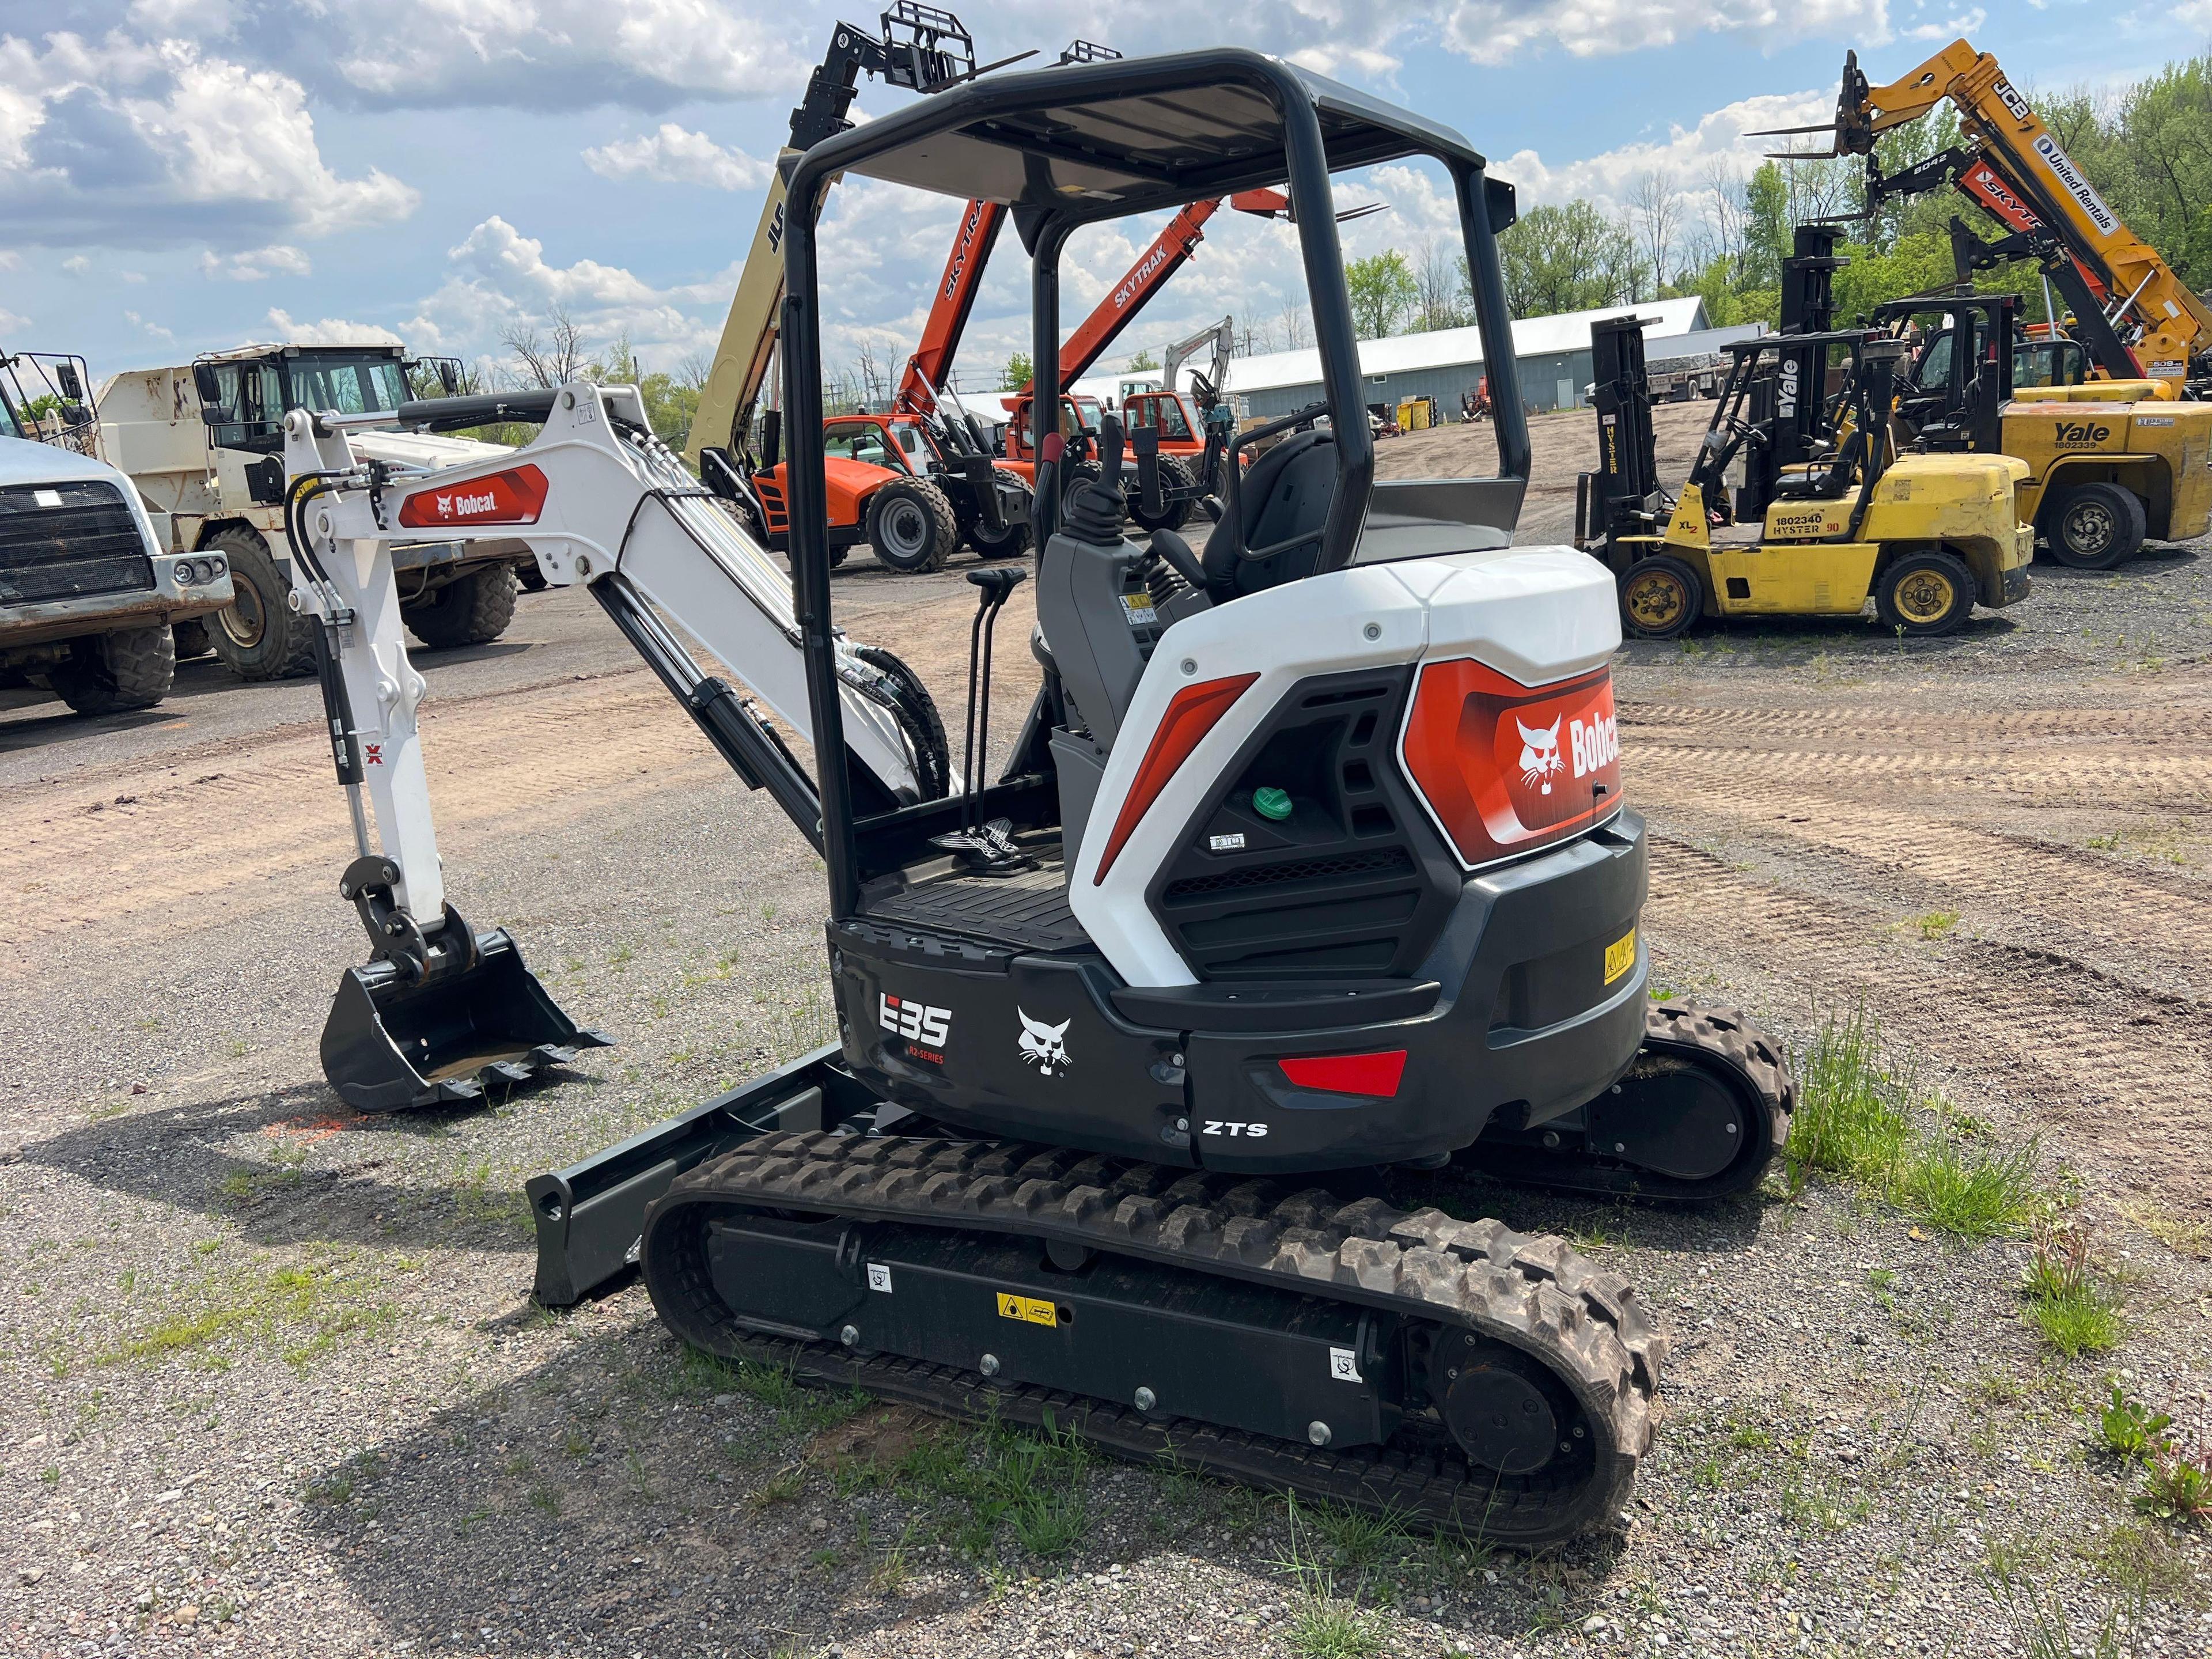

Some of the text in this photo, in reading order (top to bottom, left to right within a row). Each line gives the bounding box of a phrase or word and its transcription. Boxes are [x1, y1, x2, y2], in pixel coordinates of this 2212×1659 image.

[1993, 81, 2029, 120] JCB
[1914, 154, 1947, 175] 8042
[2048, 153, 2111, 229] United Rentals
[1114, 243, 1168, 309] SKYTRAK
[1778, 359, 1798, 406] Yale
[2055, 422, 2110, 442] Yale
[1607, 426, 1618, 474] HYSTER
[455, 491, 496, 516] Bobcat
[1774, 522, 1839, 535] HYSTER 90
[1776, 516, 1822, 525] 1802340
[879, 992, 952, 1047] E35
[908, 1046, 944, 1065] R2-SERIES
[1202, 1120, 1268, 1137] ZTS
